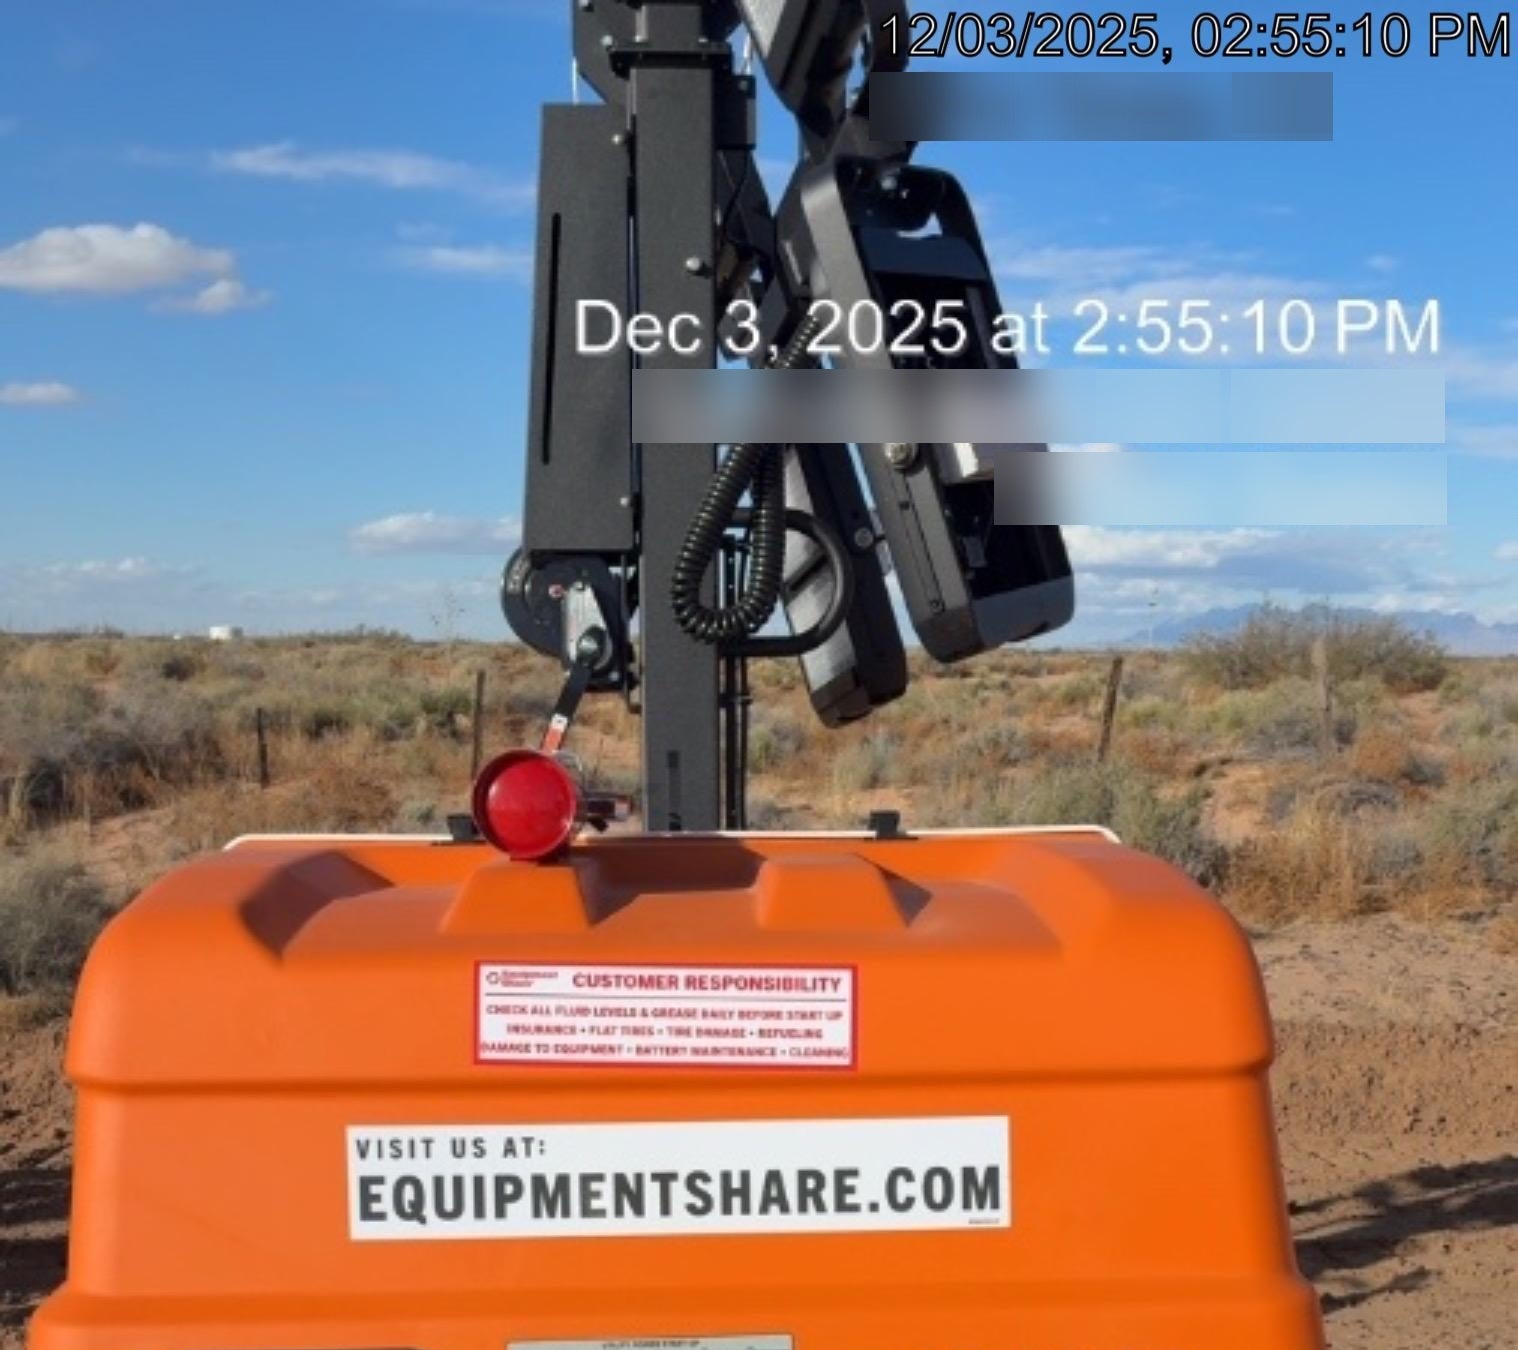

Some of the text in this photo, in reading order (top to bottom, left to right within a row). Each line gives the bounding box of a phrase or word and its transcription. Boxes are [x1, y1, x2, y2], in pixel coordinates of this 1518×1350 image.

[572, 973, 842, 993] CUSTOMER RESPONSIBILITY
[486, 1005, 528, 1015] CHECK
[531, 1005, 552, 1016] ALL
[594, 1006, 637, 1018] LEVELS
[651, 1007, 697, 1019] GREASE
[738, 1010, 784, 1021] BEFORE
[786, 1010, 823, 1021] START
[826, 1011, 843, 1021] UP
[535, 1042, 551, 1054] TO
[554, 1043, 623, 1055] EQUIPMENT
[355, 1135, 546, 1160] VISIT US AT:
[358, 1166, 1001, 1224] EQUIPMENTSHARE.COM
